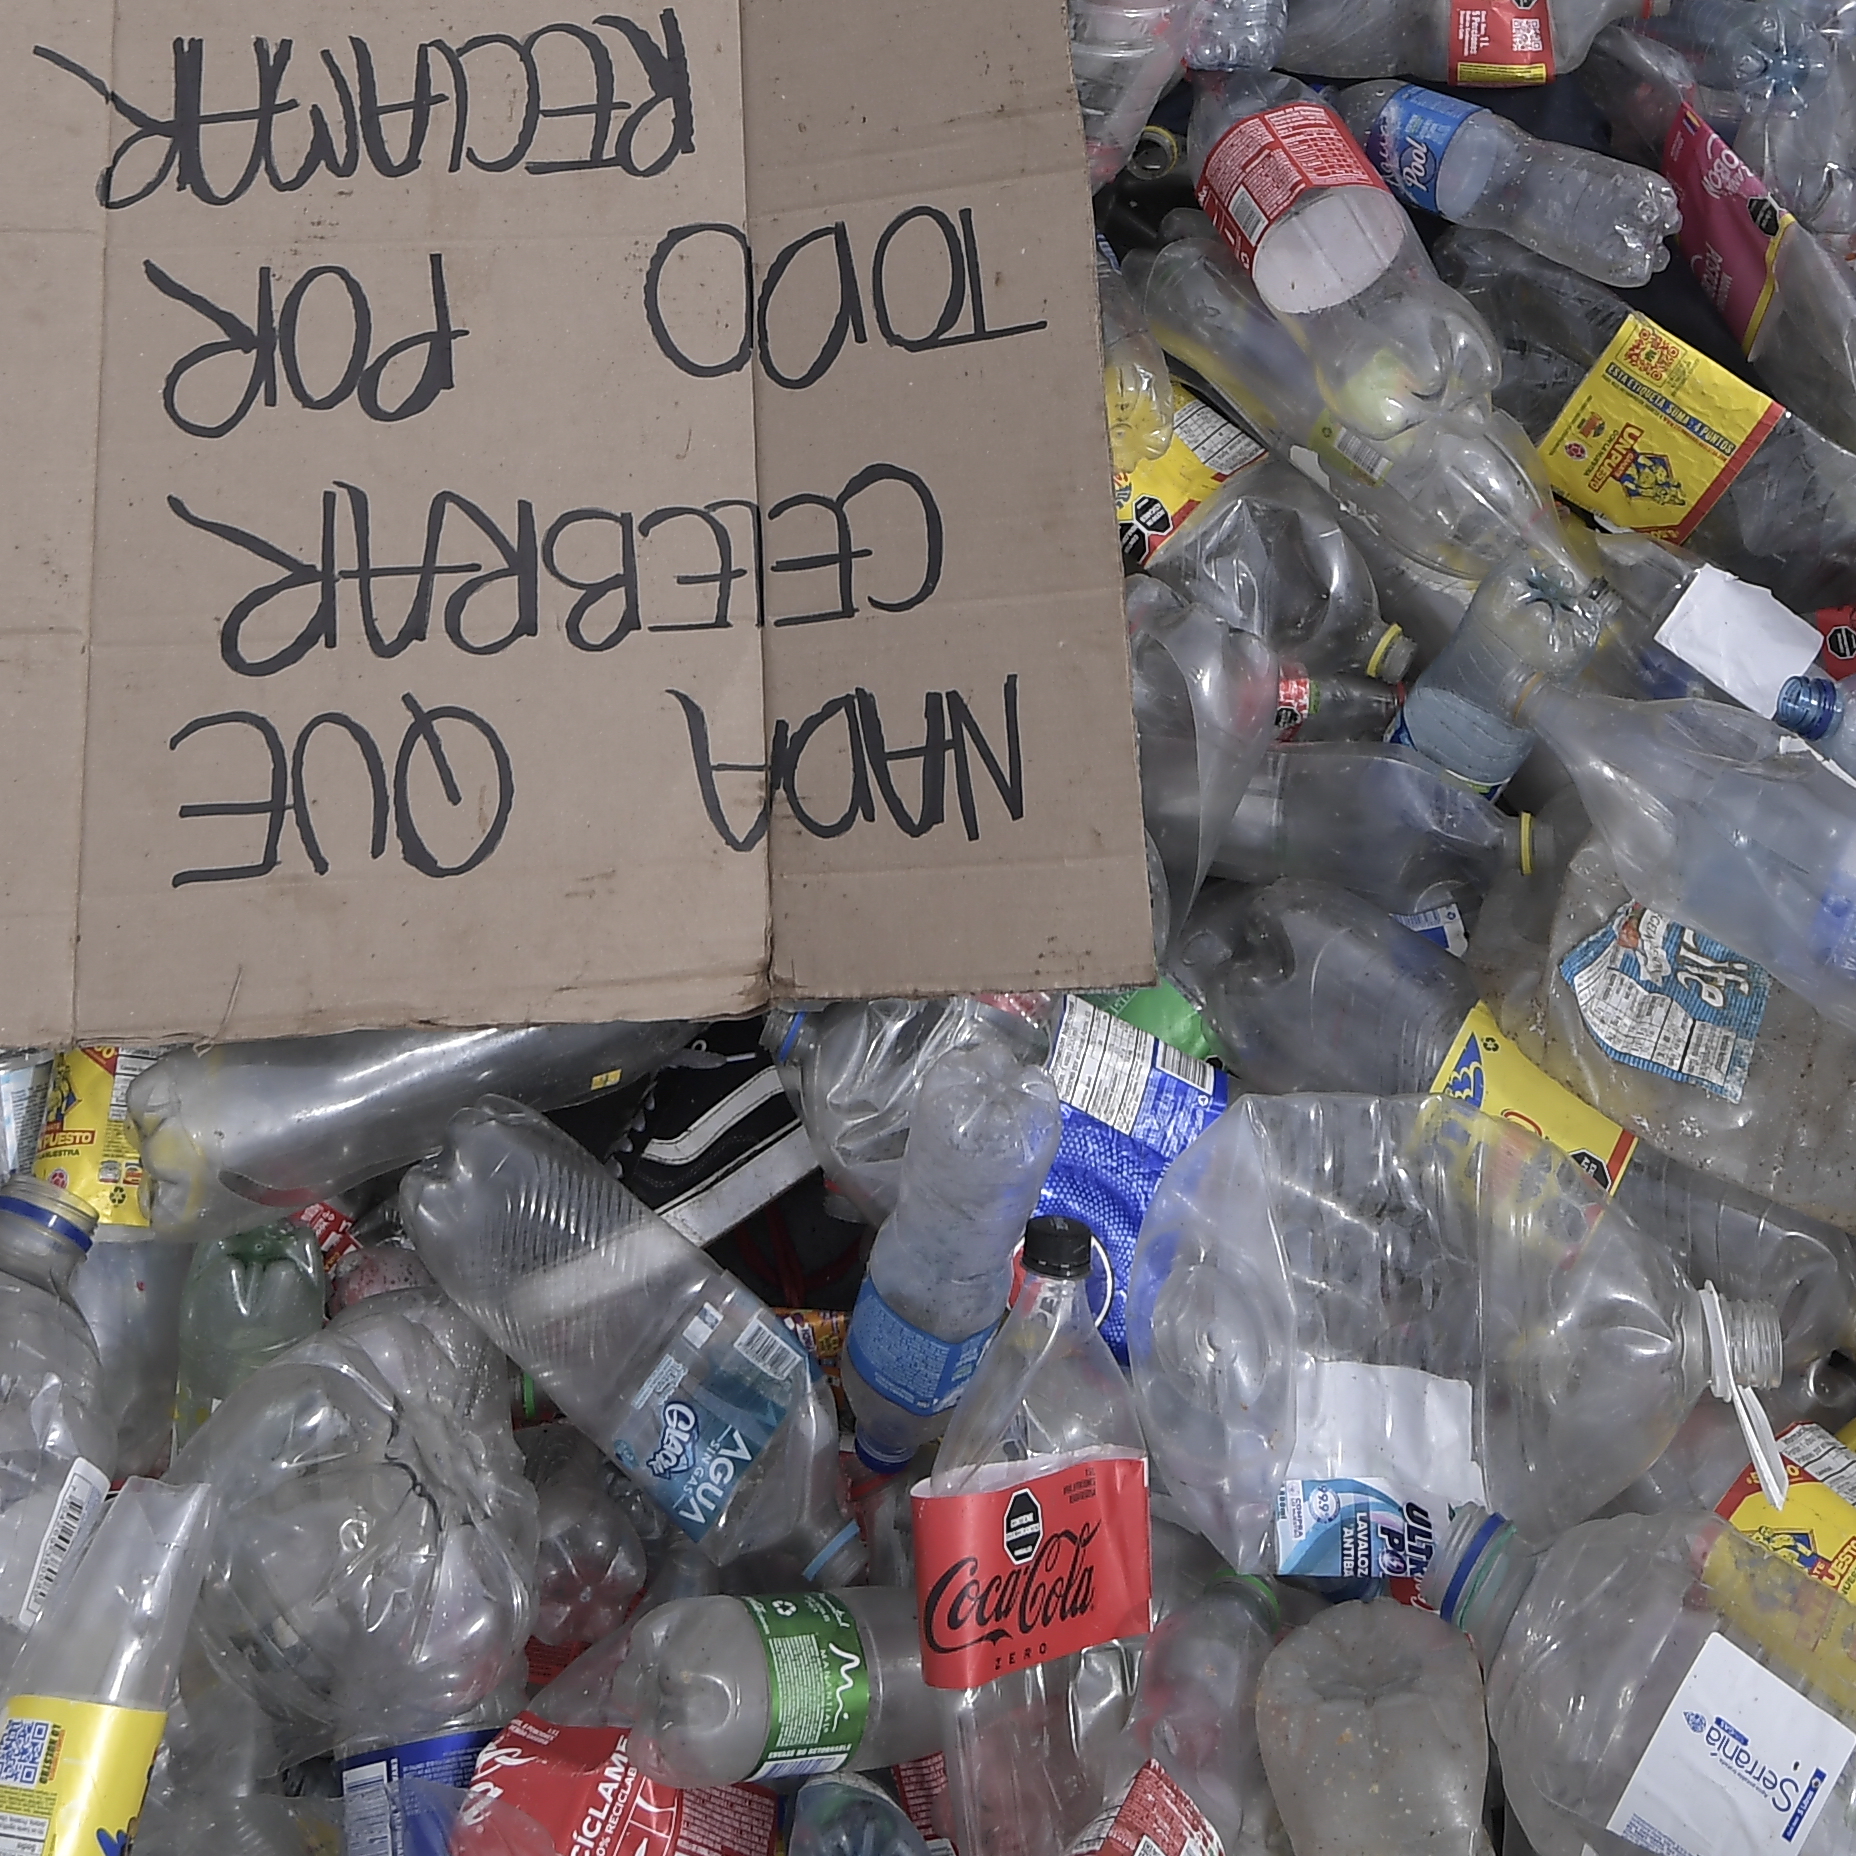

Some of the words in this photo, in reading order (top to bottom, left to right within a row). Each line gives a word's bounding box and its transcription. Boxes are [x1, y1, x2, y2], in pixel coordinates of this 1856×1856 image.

[33, 6, 695, 209] RECLAMAR
[1406, 137, 1429, 192] Pool
[644, 205, 1048, 389] TODO
[142, 251, 469, 437] POR
[1625, 375, 1667, 411] ETIQUETA
[1665, 399, 1691, 423] SUMA
[1698, 421, 1736, 455] PUNTOS
[167, 463, 945, 677] CELEBRAR
[170, 692, 515, 888] QUE
[665, 673, 1025, 852] NADA
[678, 1425, 753, 1526] AGUA
[681, 1465, 703, 1496] GAS
[697, 1439, 721, 1465] SIN
[1341, 1525, 1355, 1578] ANTIBA
[1354, 1511, 1367, 1578] LAVALOZ
[993, 1641, 1049, 1670] ZERO
